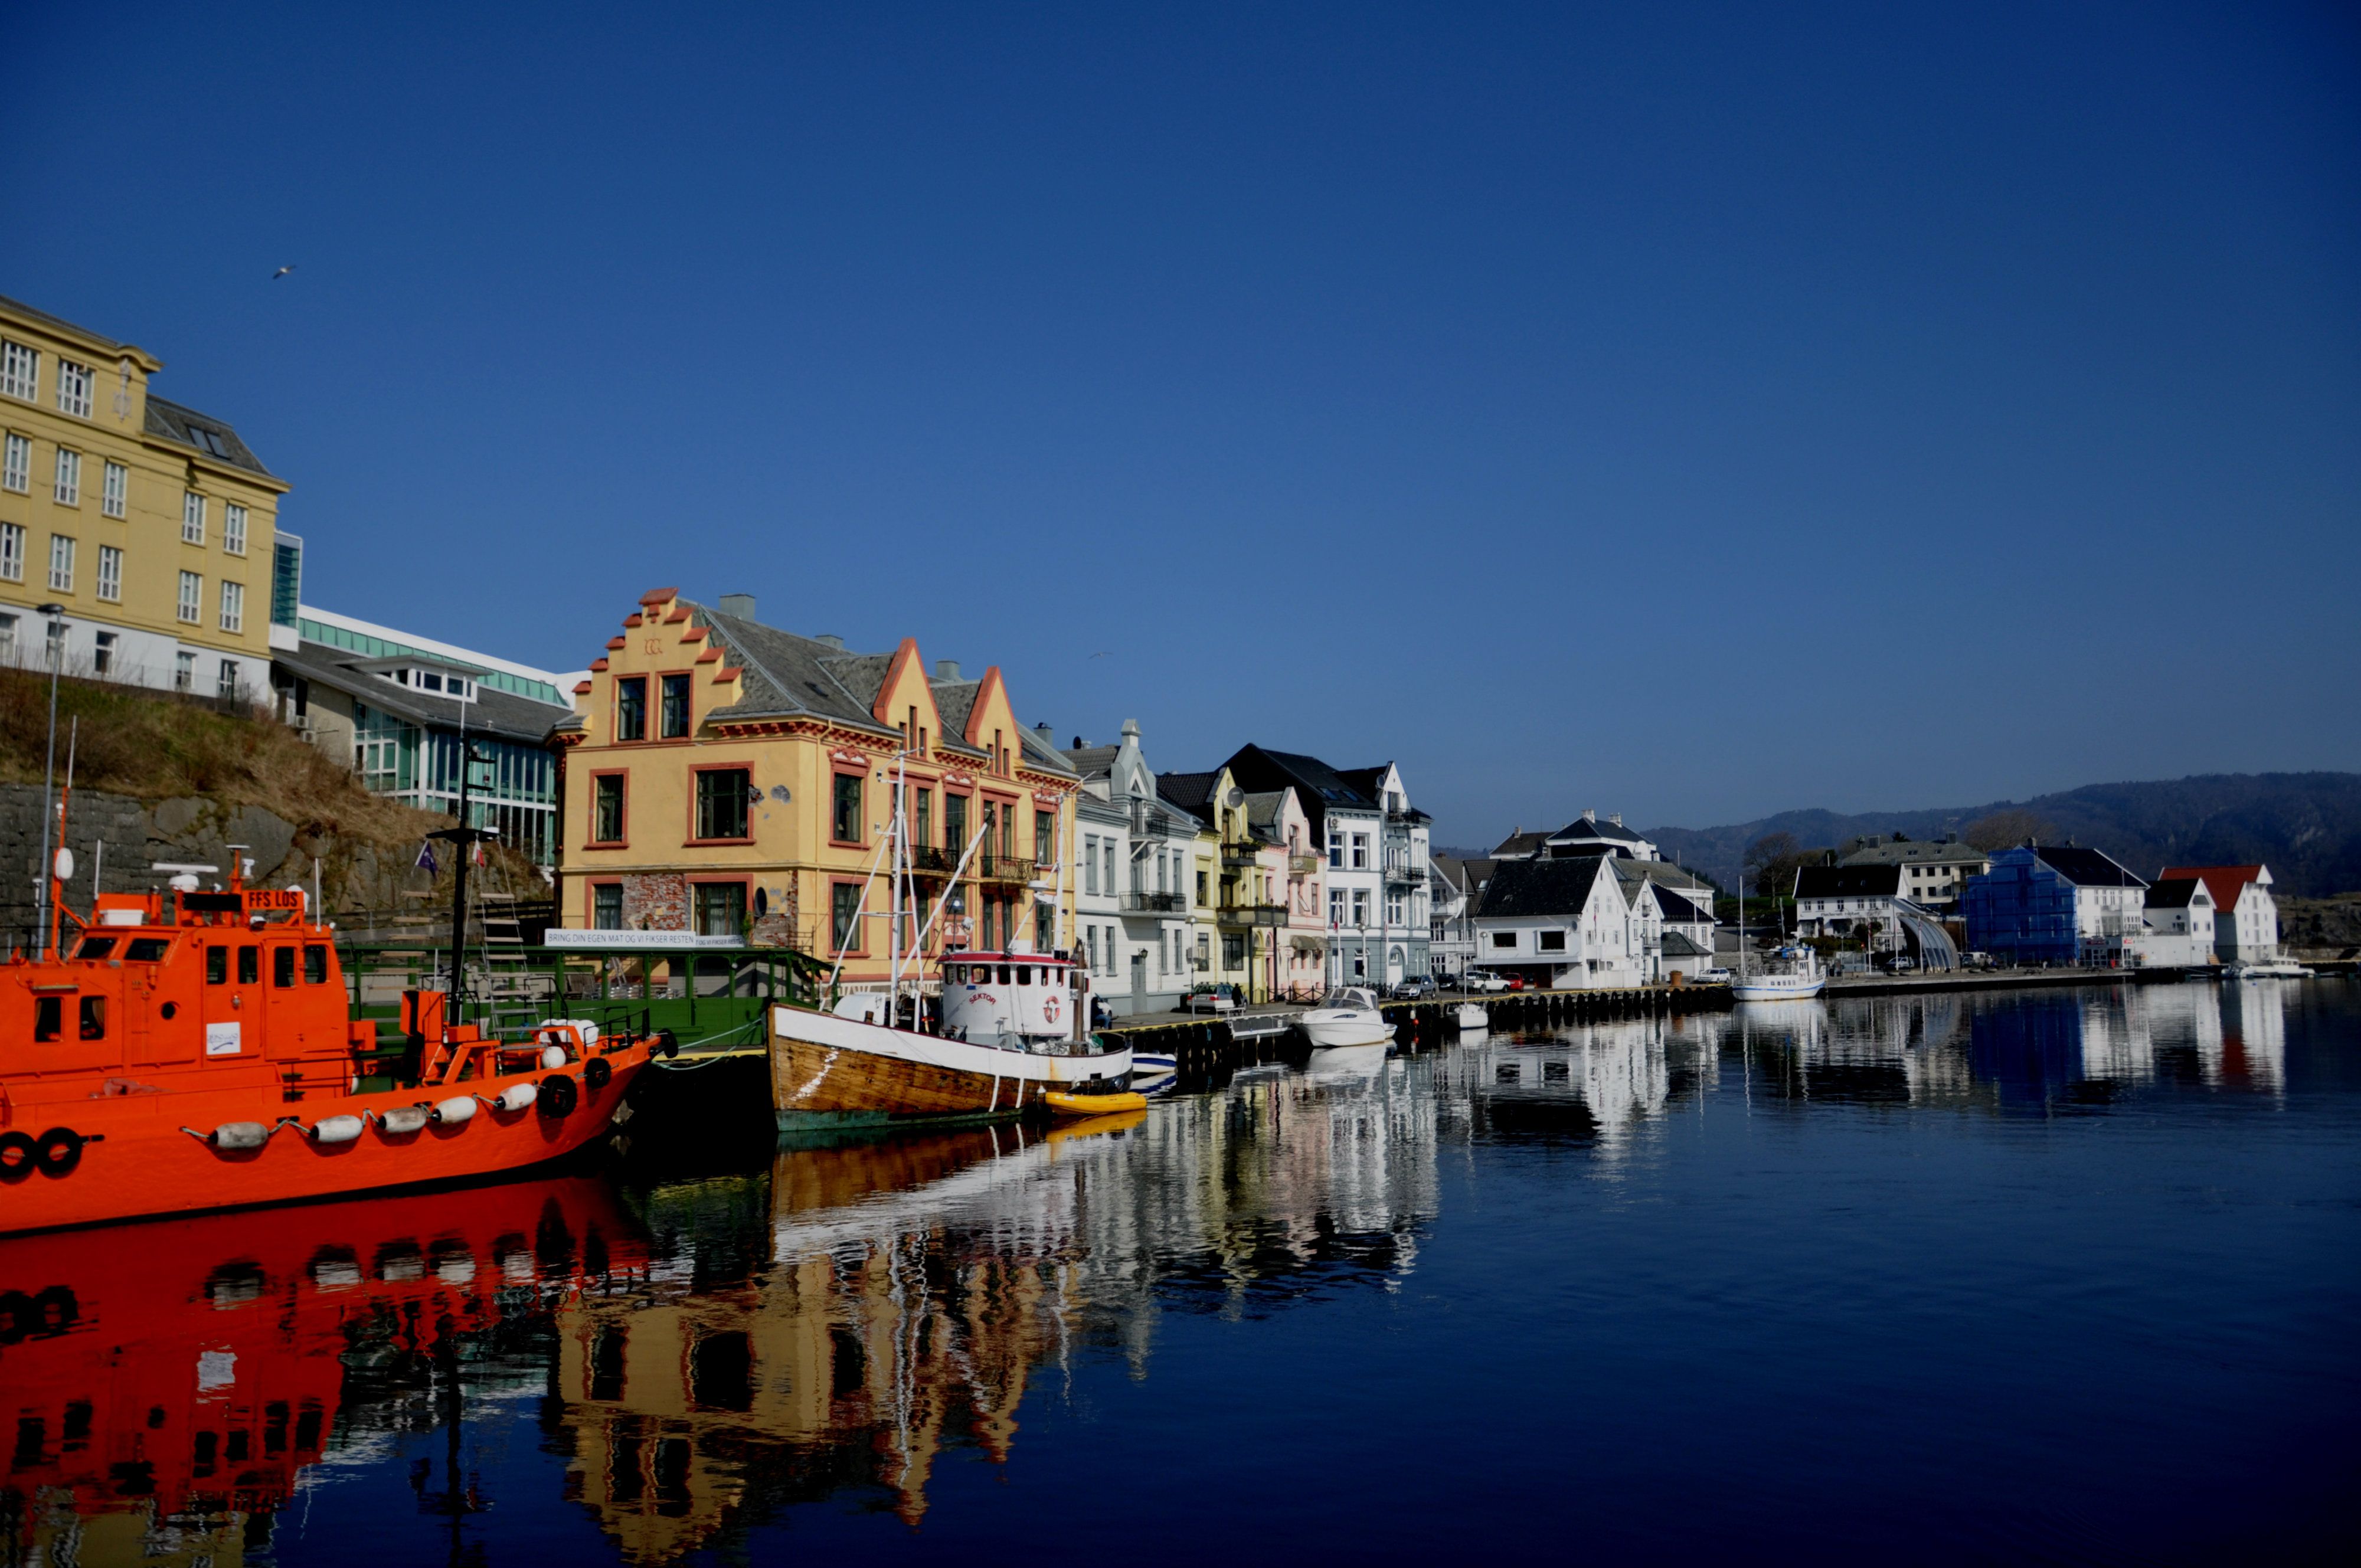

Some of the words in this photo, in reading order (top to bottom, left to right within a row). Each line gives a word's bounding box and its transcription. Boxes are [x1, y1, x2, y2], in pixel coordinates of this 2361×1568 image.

[248, 892, 270, 907] FFS
[276, 892, 297, 907] LOS
[548, 934, 571, 942] BRING
[588, 934, 606, 942] EGEN
